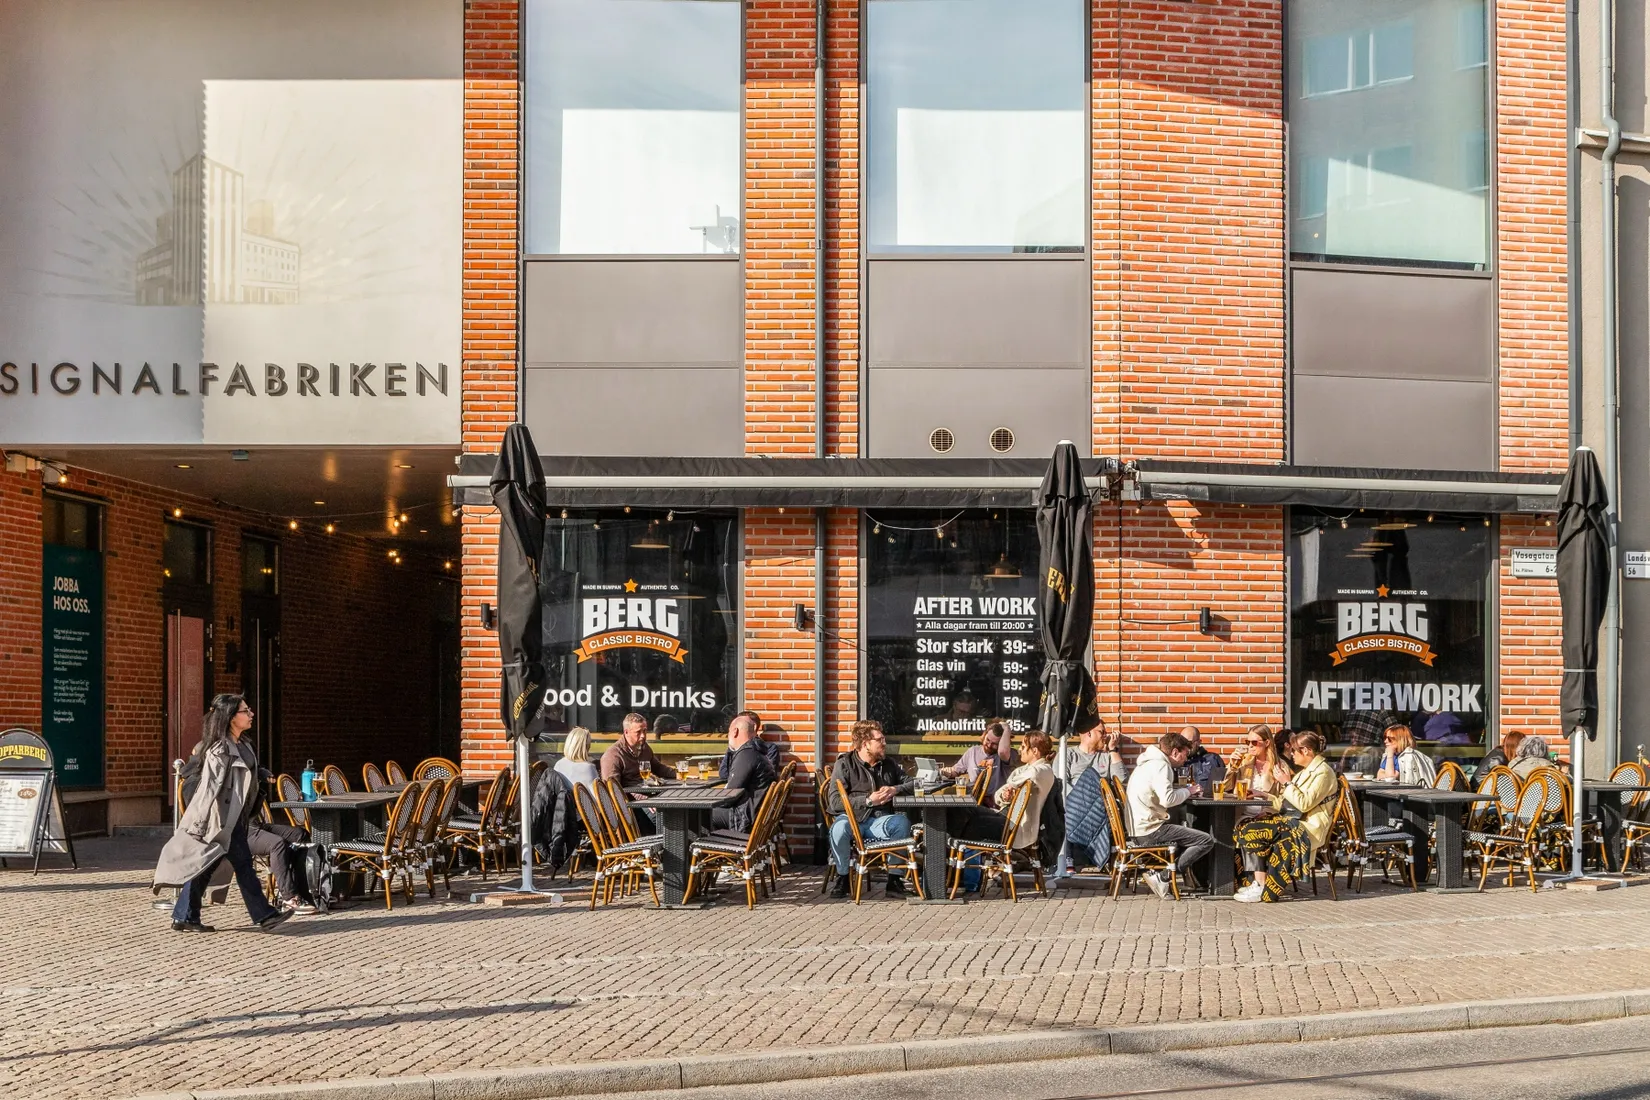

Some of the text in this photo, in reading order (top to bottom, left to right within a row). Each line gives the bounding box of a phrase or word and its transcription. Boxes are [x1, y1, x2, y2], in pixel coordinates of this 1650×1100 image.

[0, 362, 448, 397] SIGNALFABRIKEN
[1515, 551, 1555, 561] Vasagatan
[1628, 567, 1636, 575] 56
[53, 576, 80, 593] JOBBA
[53, 595, 90, 613] HOS OSS.
[913, 597, 1036, 615] AFTER WORK
[583, 598, 679, 638] BERG
[925, 621, 1025, 631] Alla dagar fram till 20:00
[1338, 602, 1428, 642] BERG
[589, 635, 673, 649] CLASSIC BISTRO
[916, 638, 1034, 655] Stor stark 39:-
[1344, 638, 1423, 653] CLASSIC BISTRO
[916, 658, 1029, 674] Glas vin 59:-
[916, 676, 1028, 691] Cider 59:-
[543, 684, 716, 708] ood & Drinks
[916, 693, 946, 706] Cava
[1003, 696, 1029, 709] 59:-
[916, 718, 986, 732] Alkoholfritt
[0, 745, 46, 761] OPPARBERG
